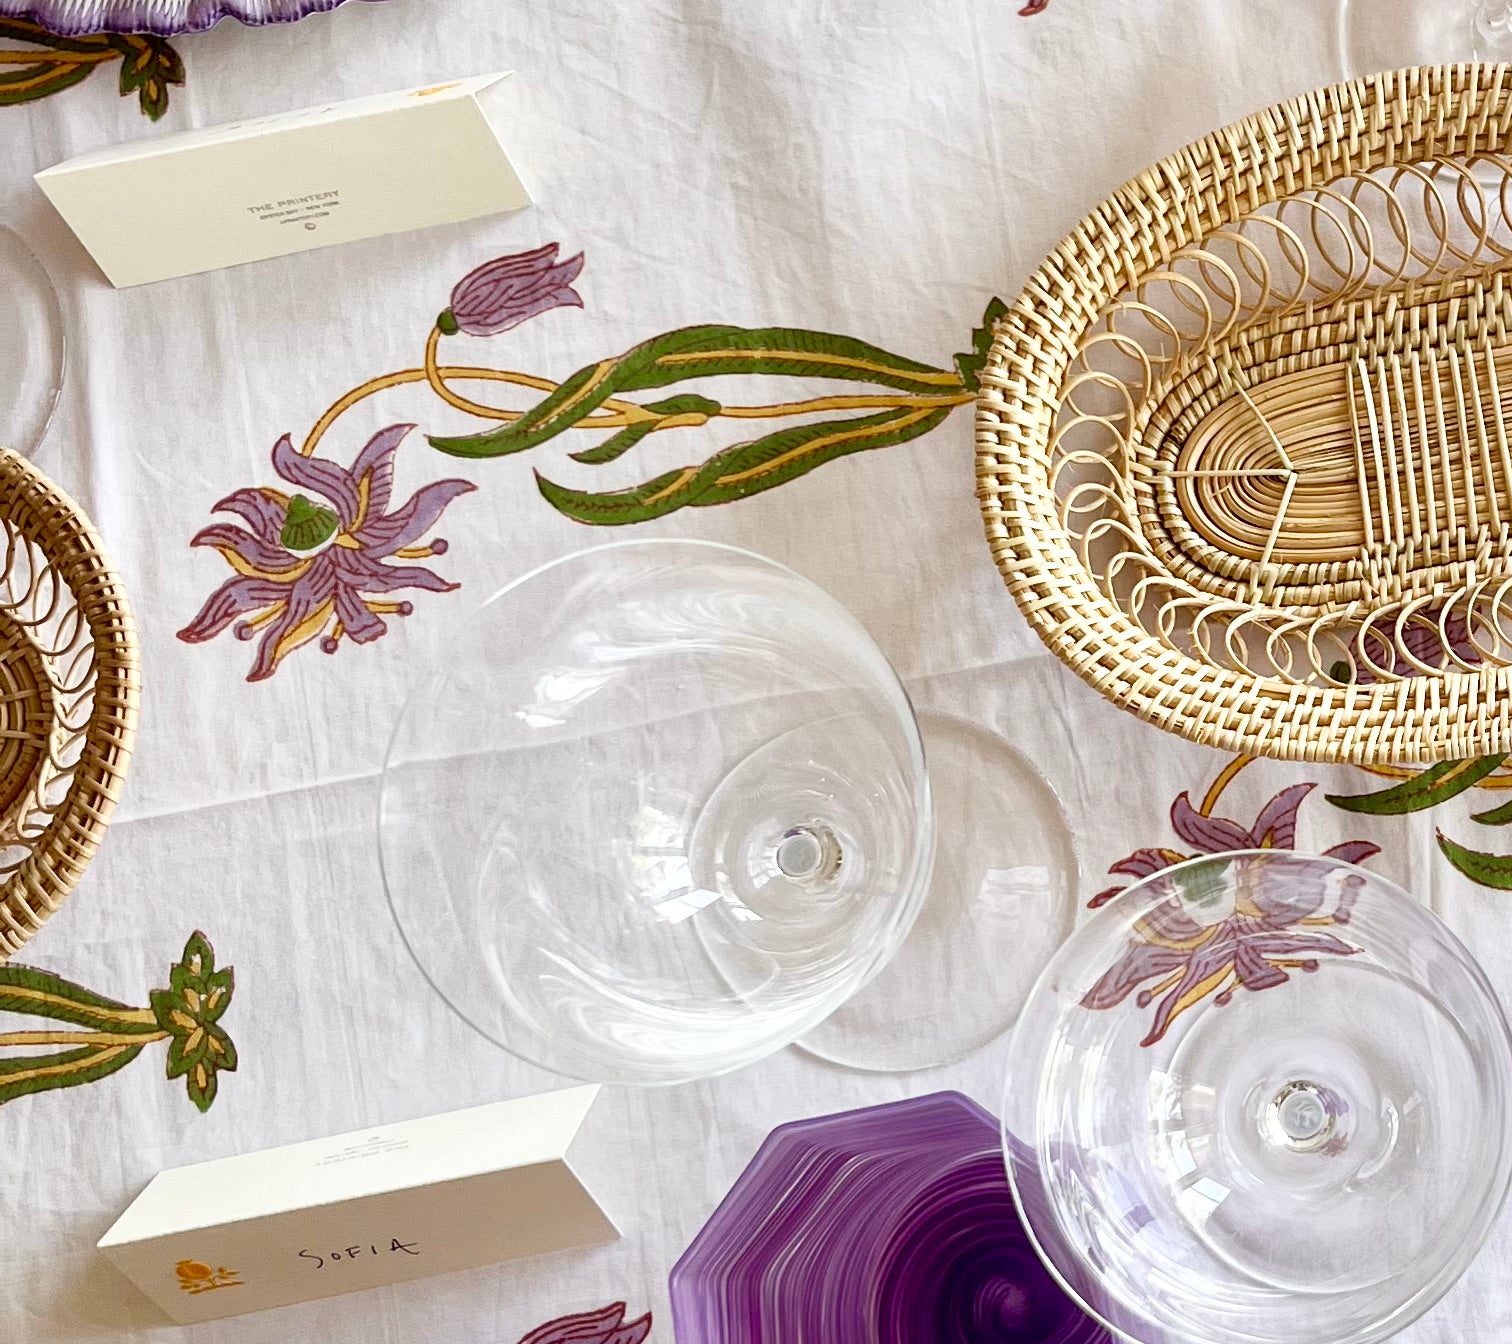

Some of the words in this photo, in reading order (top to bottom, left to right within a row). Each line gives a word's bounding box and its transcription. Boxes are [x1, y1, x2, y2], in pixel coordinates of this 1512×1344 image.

[247, 203, 274, 214] THE
[277, 190, 339, 207] PRINTERY
[299, 1238, 420, 1269] SOFIA
